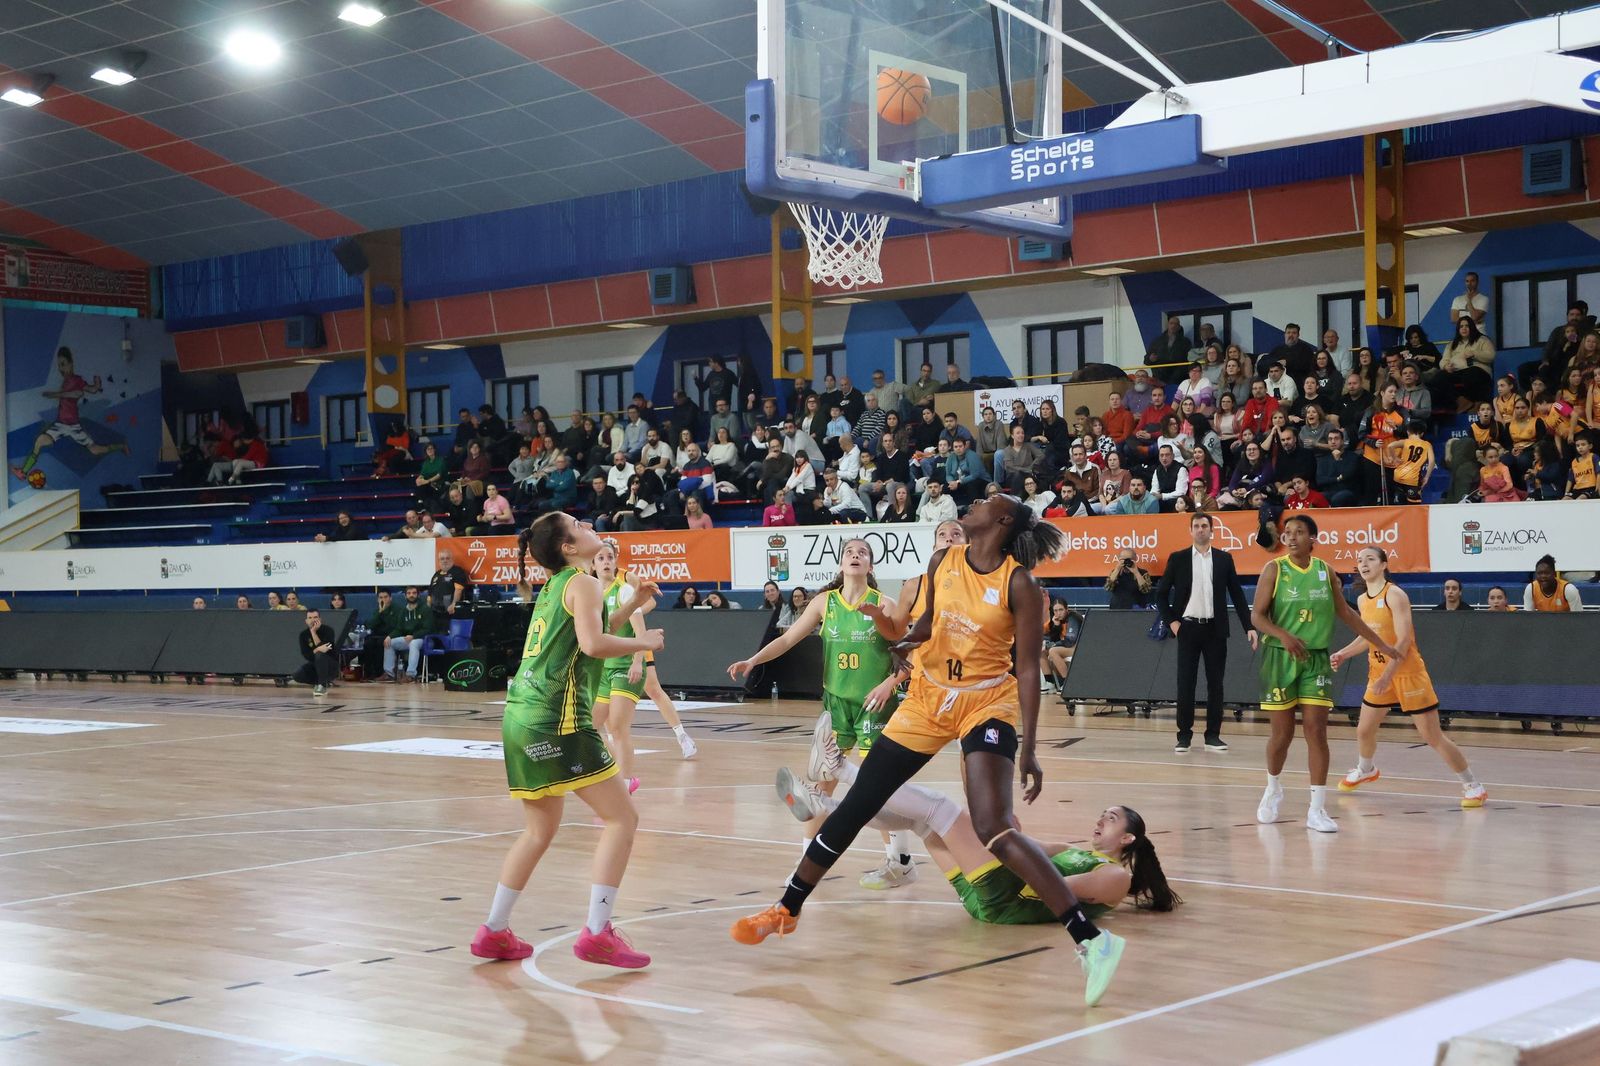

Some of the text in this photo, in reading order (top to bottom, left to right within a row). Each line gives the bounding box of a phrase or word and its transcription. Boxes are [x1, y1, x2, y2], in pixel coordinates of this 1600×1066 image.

[1011, 139, 1094, 164] Schelde
[1011, 155, 1094, 182] Sports
[1408, 445, 1424, 463] 18
[1113, 529, 1158, 549] salud
[1346, 522, 1399, 544] salud
[1484, 529, 1548, 545] ZAMORA
[803, 532, 921, 565] ZAORA
[1334, 549, 1399, 560] ZAA
[272, 560, 297, 571] ZAMORA
[384, 557, 413, 568] ZAMORA
[1103, 553, 1158, 564] ZAORA
[169, 563, 192, 573] ZAMORA
[627, 562, 692, 580] ZAMORA
[1299, 609, 1313, 623] 31
[838, 652, 860, 671] 30
[946, 658, 963, 681] 14
[1272, 687, 1287, 702] 31
